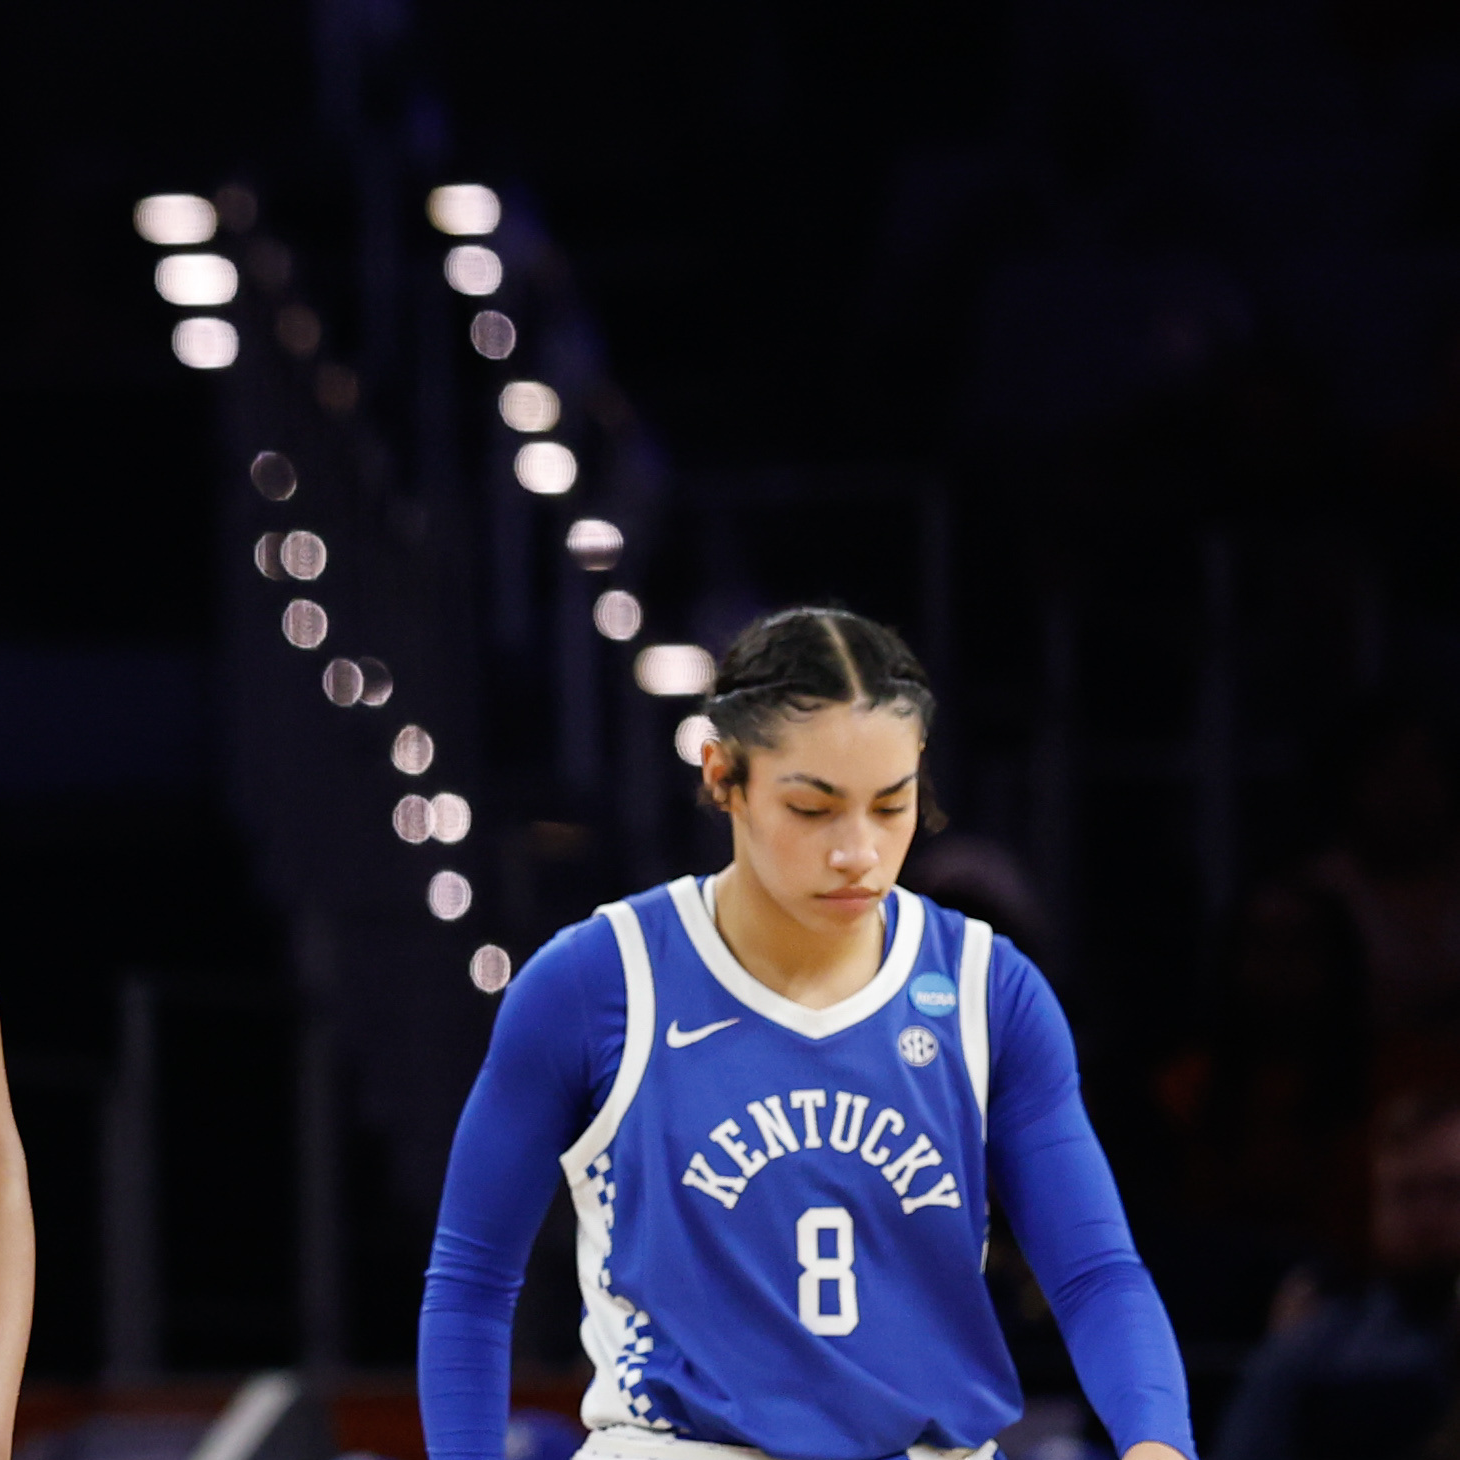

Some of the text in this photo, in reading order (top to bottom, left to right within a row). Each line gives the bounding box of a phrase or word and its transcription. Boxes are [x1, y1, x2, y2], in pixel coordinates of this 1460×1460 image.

[899, 1028, 935, 1063] SEC
[682, 1089, 961, 1215] KENTUCKY
[795, 1206, 860, 1337] 8
